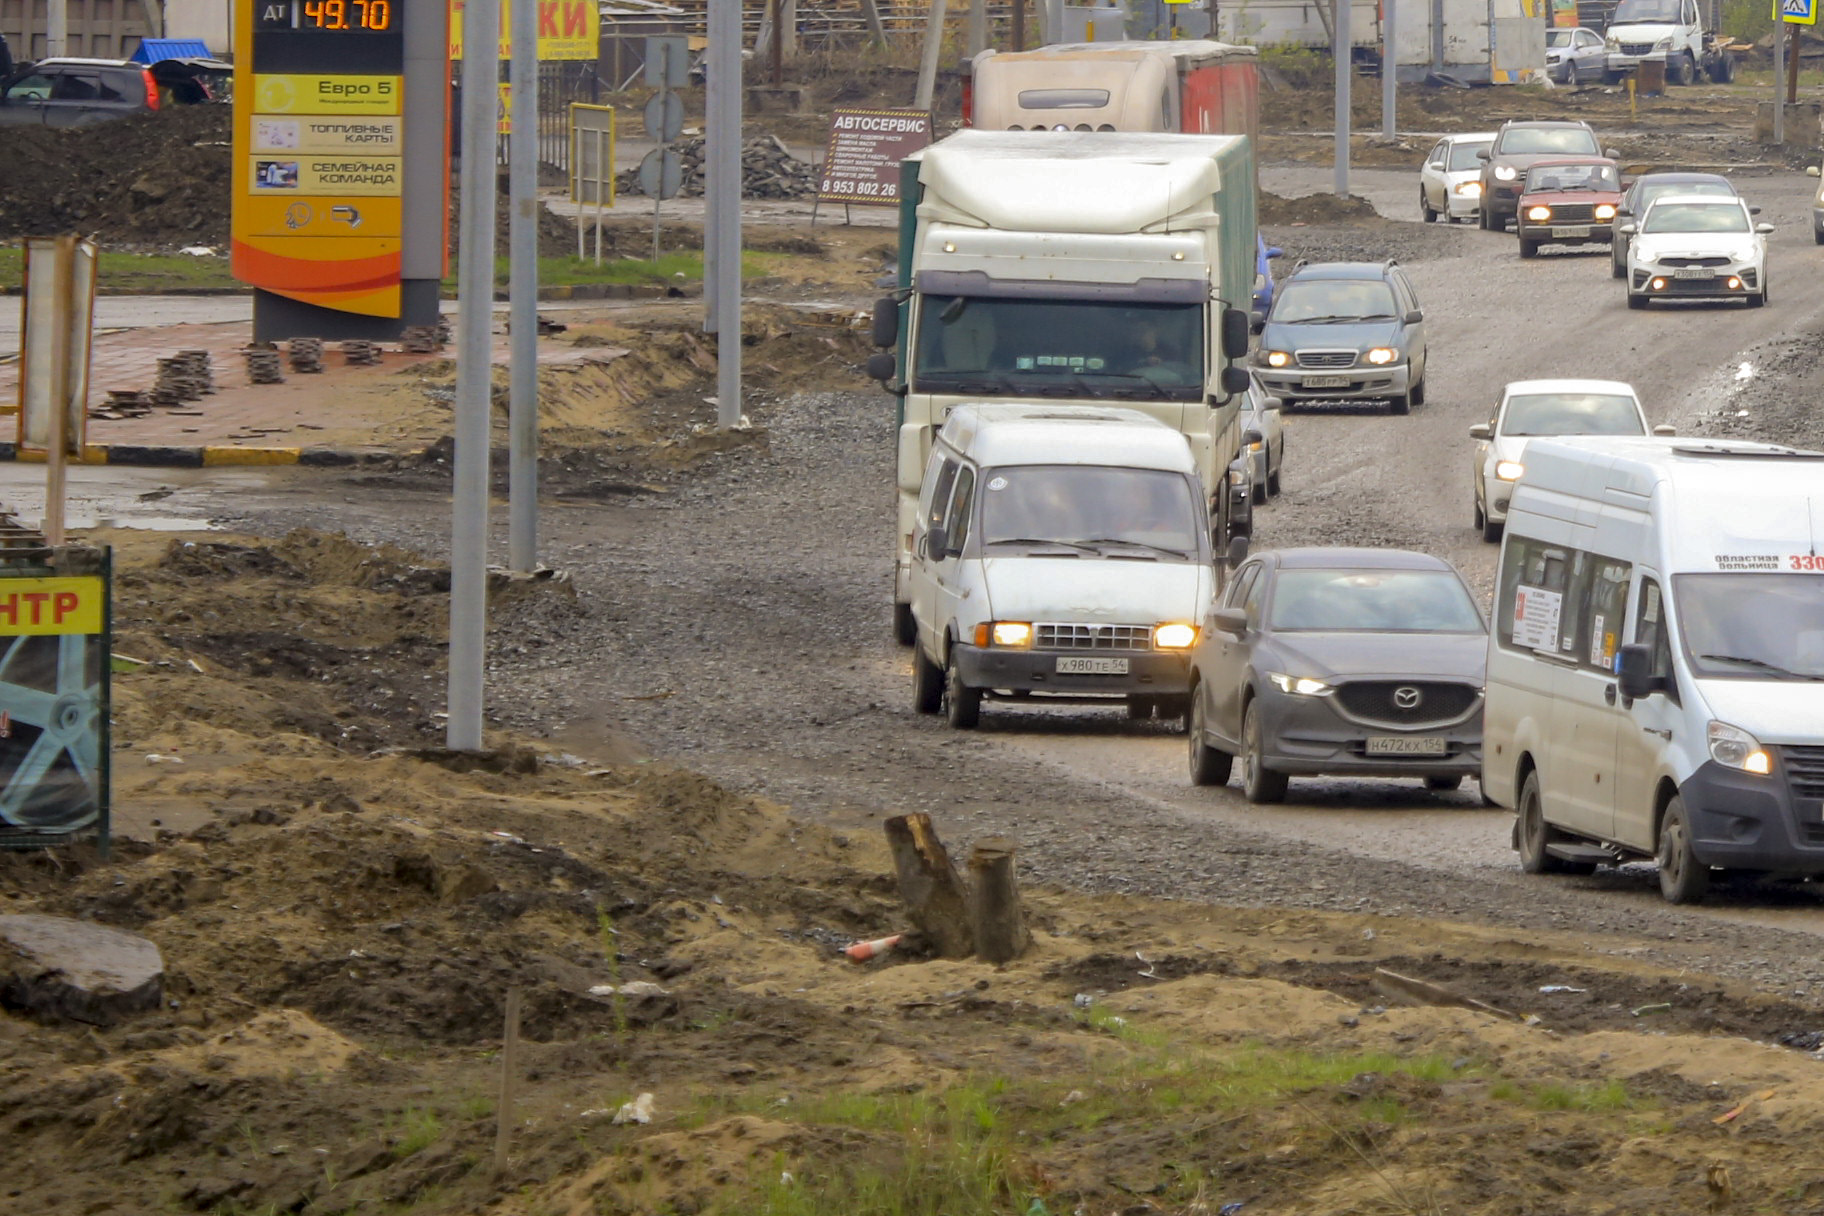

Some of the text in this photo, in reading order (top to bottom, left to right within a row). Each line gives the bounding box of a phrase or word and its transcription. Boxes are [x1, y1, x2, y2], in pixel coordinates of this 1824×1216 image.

[263, 5, 285, 21] ДТ
[318, 81, 392, 97] Евро 5
[309, 124, 393, 134] ТОПЛИВНЫЕ
[833, 116, 925, 133] АВТОСЕРВИС
[344, 135, 393, 143] КАРТЫ
[311, 161, 396, 172] СЕМЕЙНАЯ
[319, 175, 395, 185] КОМАНДА
[822, 180, 896, 196] 8 953 802 26
